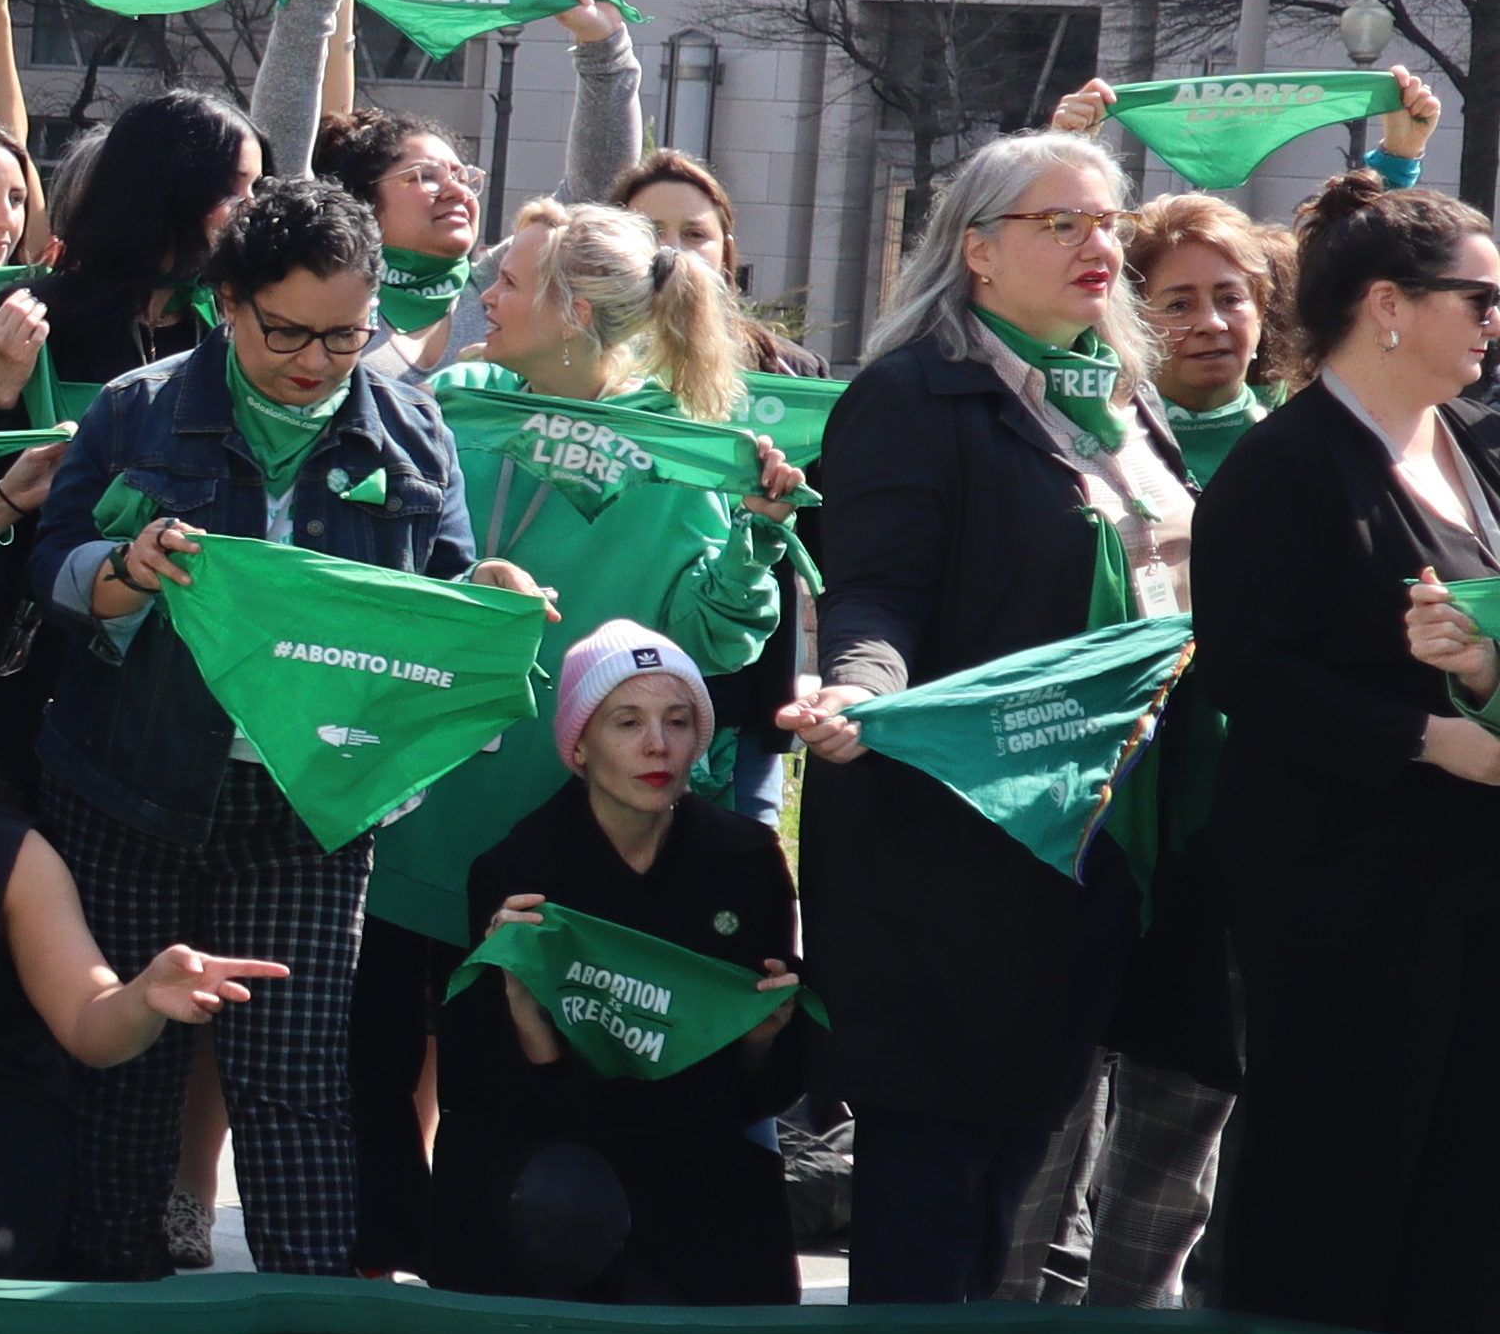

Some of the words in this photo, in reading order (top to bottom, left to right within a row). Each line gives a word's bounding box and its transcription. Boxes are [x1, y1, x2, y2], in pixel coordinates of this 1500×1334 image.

[1173, 82, 1325, 107] ABORTO
[521, 412, 654, 471] ABORTO
[532, 439, 628, 485] LIBRE
[273, 640, 388, 674] #ABORTO
[391, 659, 455, 689] LIBRE
[1003, 698, 1086, 732] SEGURO,
[1007, 716, 1107, 754] GRATUITO.
[565, 960, 672, 1016] ABORTION
[608, 997, 623, 1013] IS
[561, 995, 666, 1063] FREEDOM
